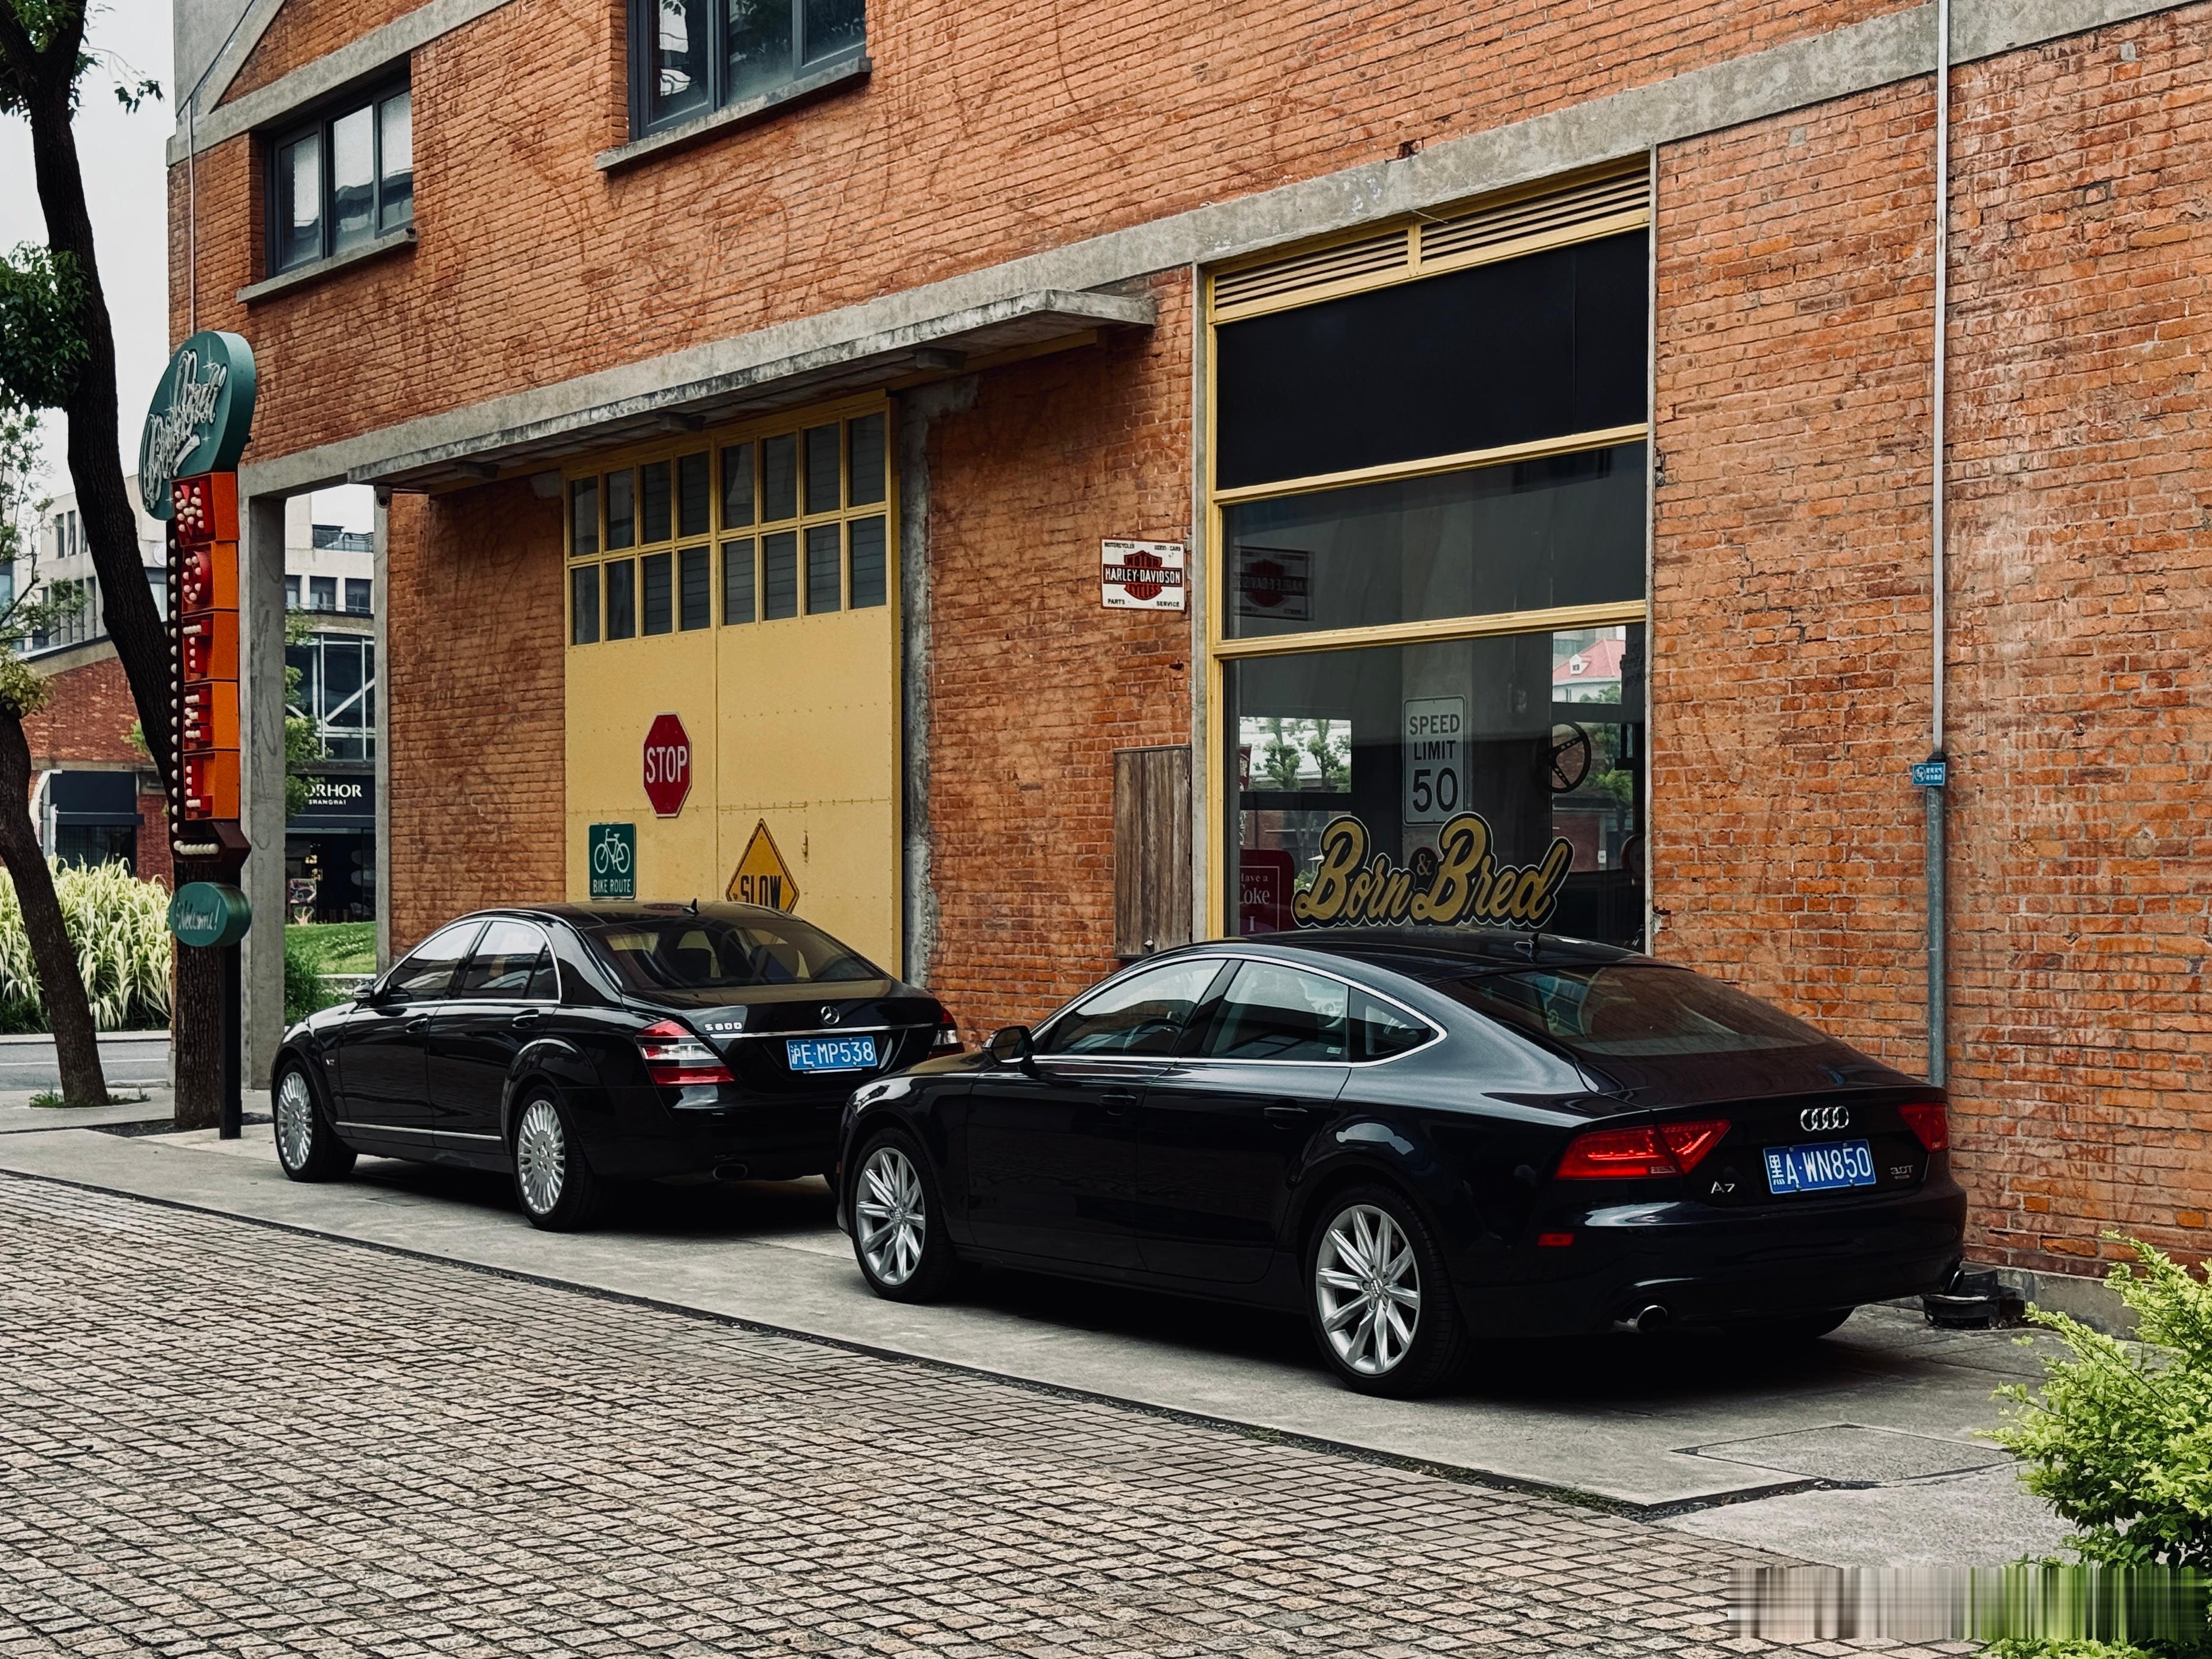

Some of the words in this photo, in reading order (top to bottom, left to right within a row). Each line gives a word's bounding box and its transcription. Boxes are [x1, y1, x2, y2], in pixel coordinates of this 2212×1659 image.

[1126, 552, 1160, 568] MOTOR
[1105, 568, 1180, 584] HARLEY-DAVIDSON
[1129, 584, 1158, 598] CYCLES
[1409, 713, 1460, 735] SPEED
[1414, 740, 1457, 761] LIMIT
[646, 746, 688, 783] STOP
[1412, 767, 1458, 813] 50
[1294, 820, 1414, 922] Born
[1411, 817, 1569, 922] Bred
[1417, 853, 1433, 876] &
[593, 879, 608, 893] BIKE
[610, 878, 631, 893] ROUTE
[740, 874, 782, 910] SLOW
[1710, 1181, 1736, 1195] A7
